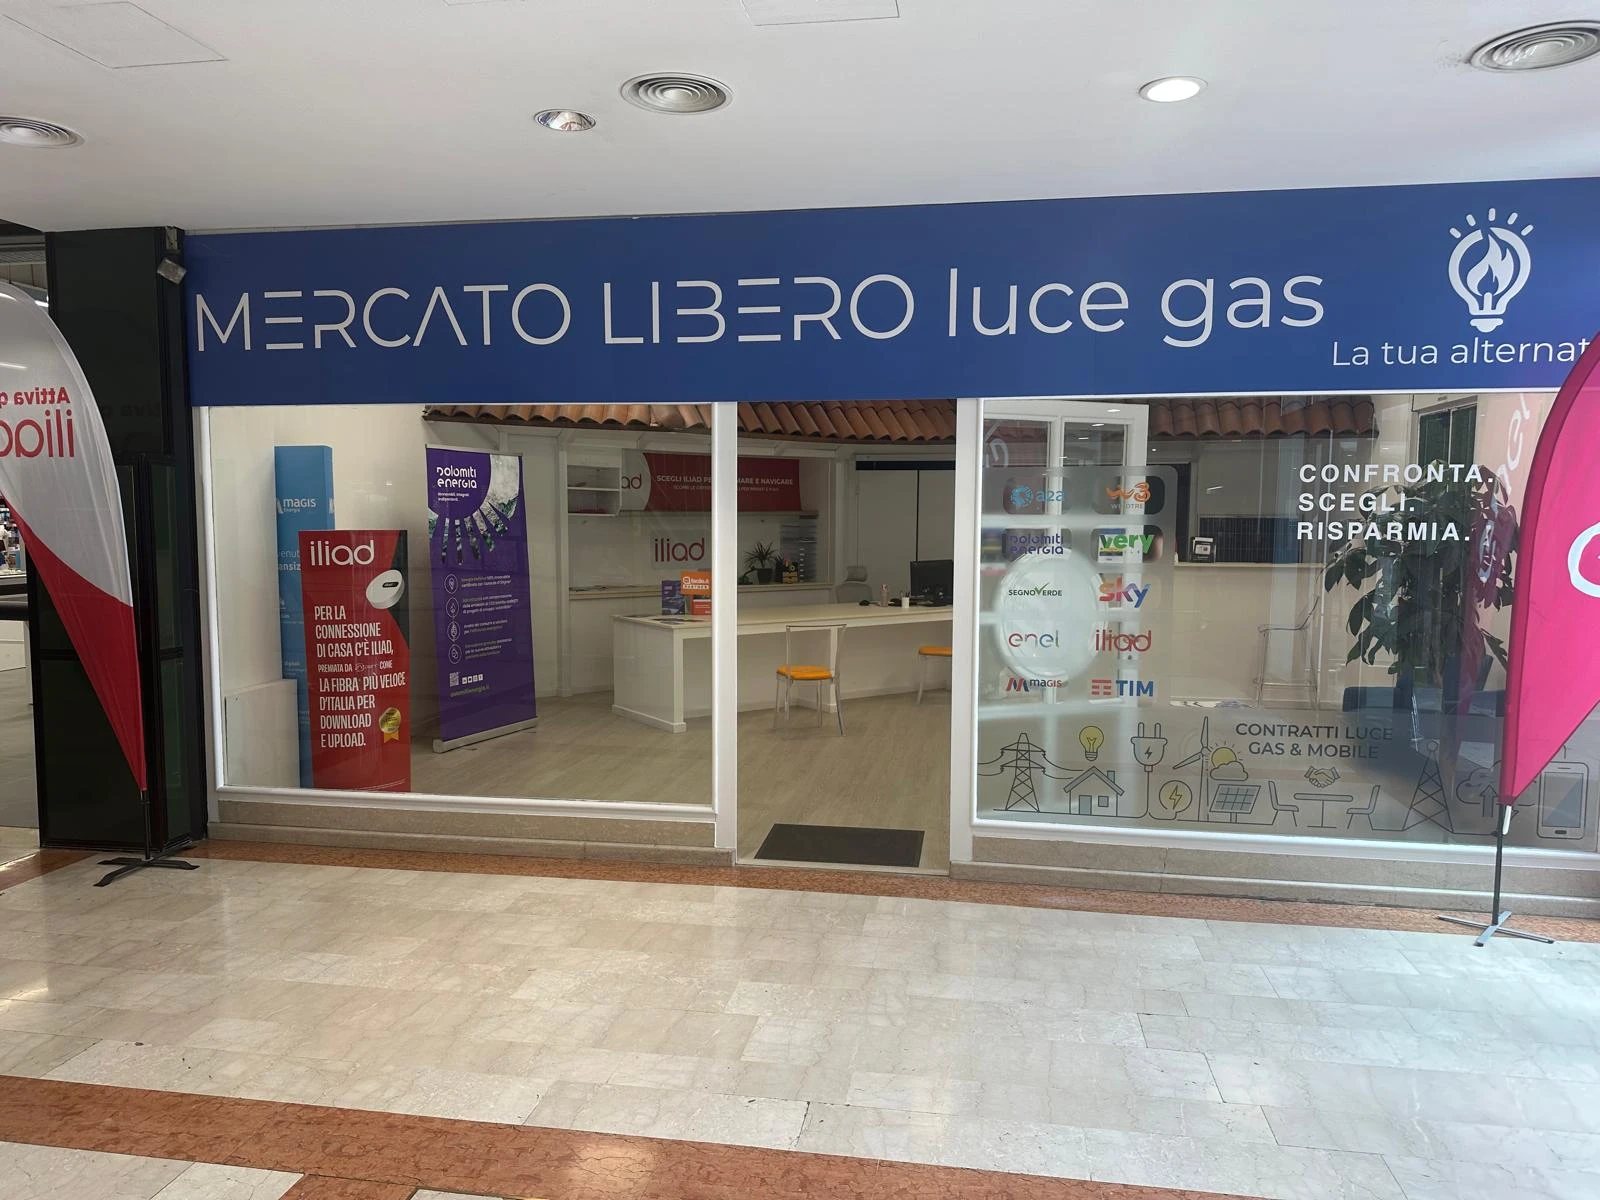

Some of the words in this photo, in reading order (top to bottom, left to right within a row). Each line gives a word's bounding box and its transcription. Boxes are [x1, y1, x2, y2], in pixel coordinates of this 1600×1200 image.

[195, 282, 572, 352] MERCATO
[603, 273, 915, 345] LIBERO
[949, 267, 1129, 337] luce
[1160, 274, 1325, 348] gas
[1332, 341, 1369, 366] La
[1380, 342, 1438, 365] tua
[1299, 463, 1494, 484] CONFRONTA.
[1298, 493, 1415, 513] SCEGLI.
[1296, 521, 1471, 542] RISPARMIA.
[310, 539, 375, 566] iliad
[654, 537, 705, 562] iliad
[1098, 534, 1156, 554] very
[1098, 575, 1151, 608] sky
[314, 605, 333, 621] PER
[334, 605, 347, 620] LA
[315, 622, 382, 640] CONNESSIONE
[1008, 630, 1060, 648] enel
[1095, 629, 1152, 652] iliad
[316, 643, 326, 658] DI
[327, 641, 353, 658] CASA
[354, 638, 370, 657] C'È
[371, 639, 394, 656] ILIAD,
[344, 663, 353, 673] DA
[319, 678, 330, 693] LA
[363, 672, 379, 691] PIÙ
[379, 671, 406, 689] VELOCE
[1029, 678, 1062, 688] magis
[1116, 680, 1154, 697] TIM
[319, 696, 356, 711] D'ITALIA
[357, 694, 376, 710] PER
[320, 713, 372, 730] DOWNLOAD
[1235, 722, 1339, 739] CONTRATTI
[1345, 725, 1393, 740] LUCE
[321, 732, 326, 748] E
[328, 731, 366, 748] UPLOAD.
[1249, 741, 1285, 756] GAS
[1289, 743, 1302, 757] &
[1307, 743, 1379, 759] MOBILE
